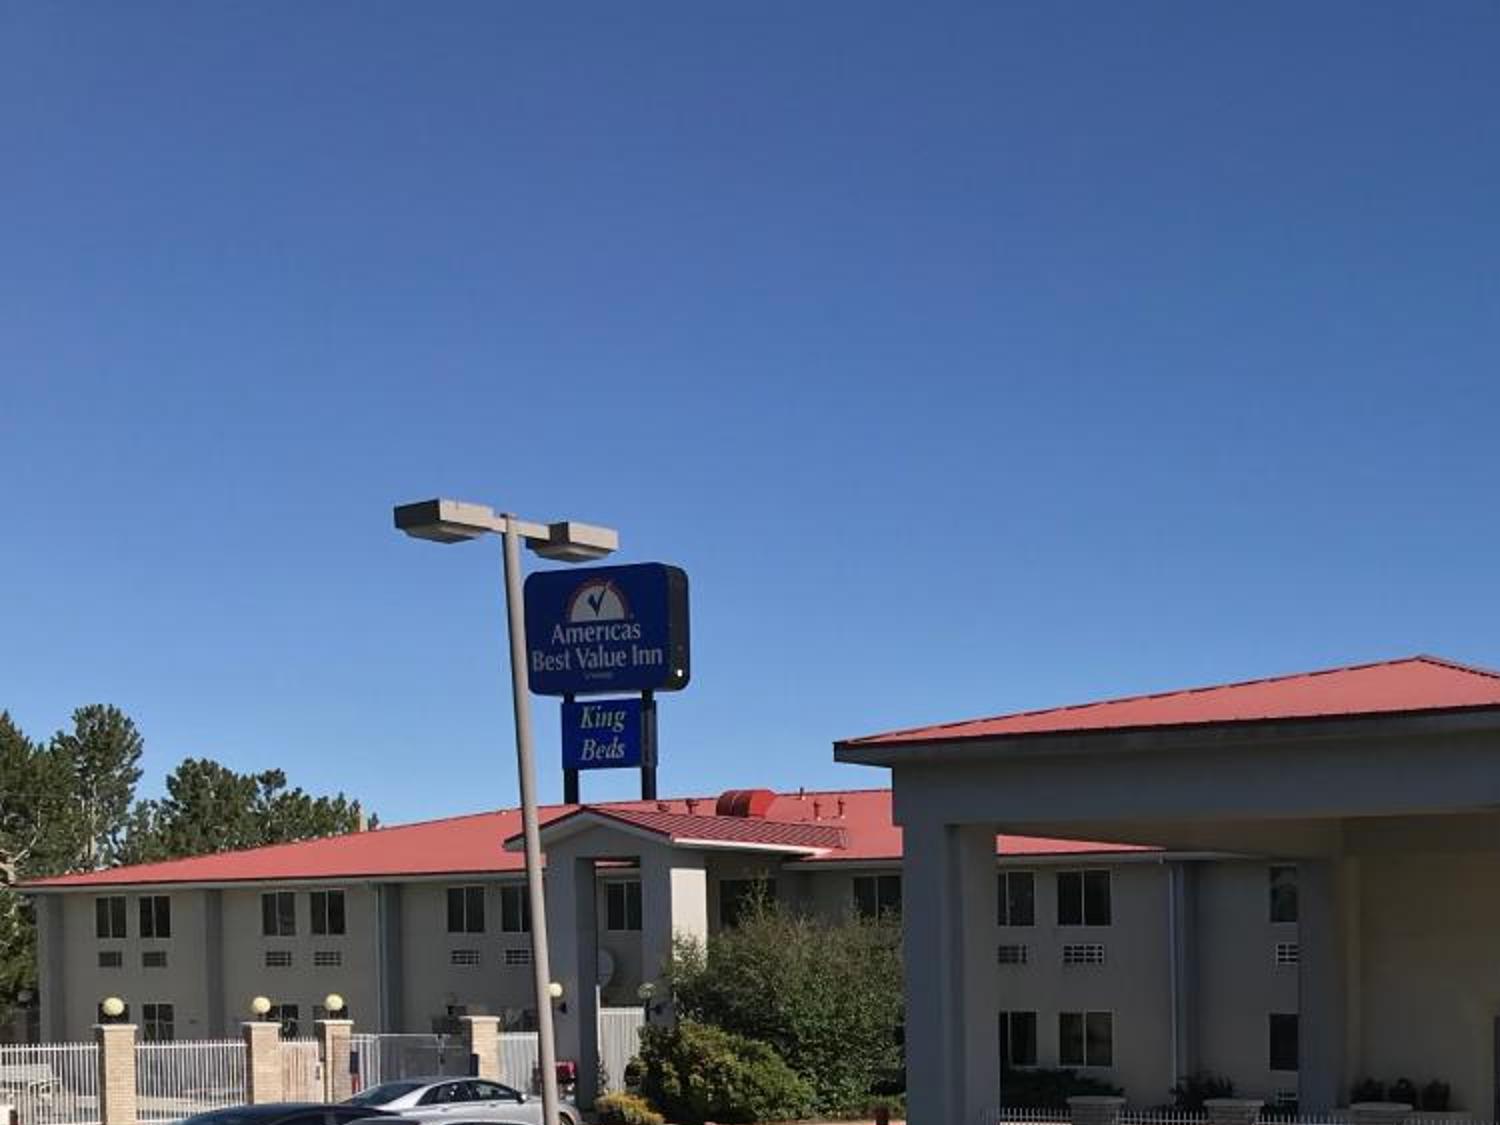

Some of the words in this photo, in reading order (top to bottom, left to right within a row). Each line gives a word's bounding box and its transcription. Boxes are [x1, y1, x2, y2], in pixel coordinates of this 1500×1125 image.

[551, 623, 641, 645] Americas
[532, 650, 572, 671] Best
[576, 645, 627, 669] Value
[632, 645, 663, 666] Inn
[580, 705, 627, 732] King
[581, 736, 625, 761] Beds
